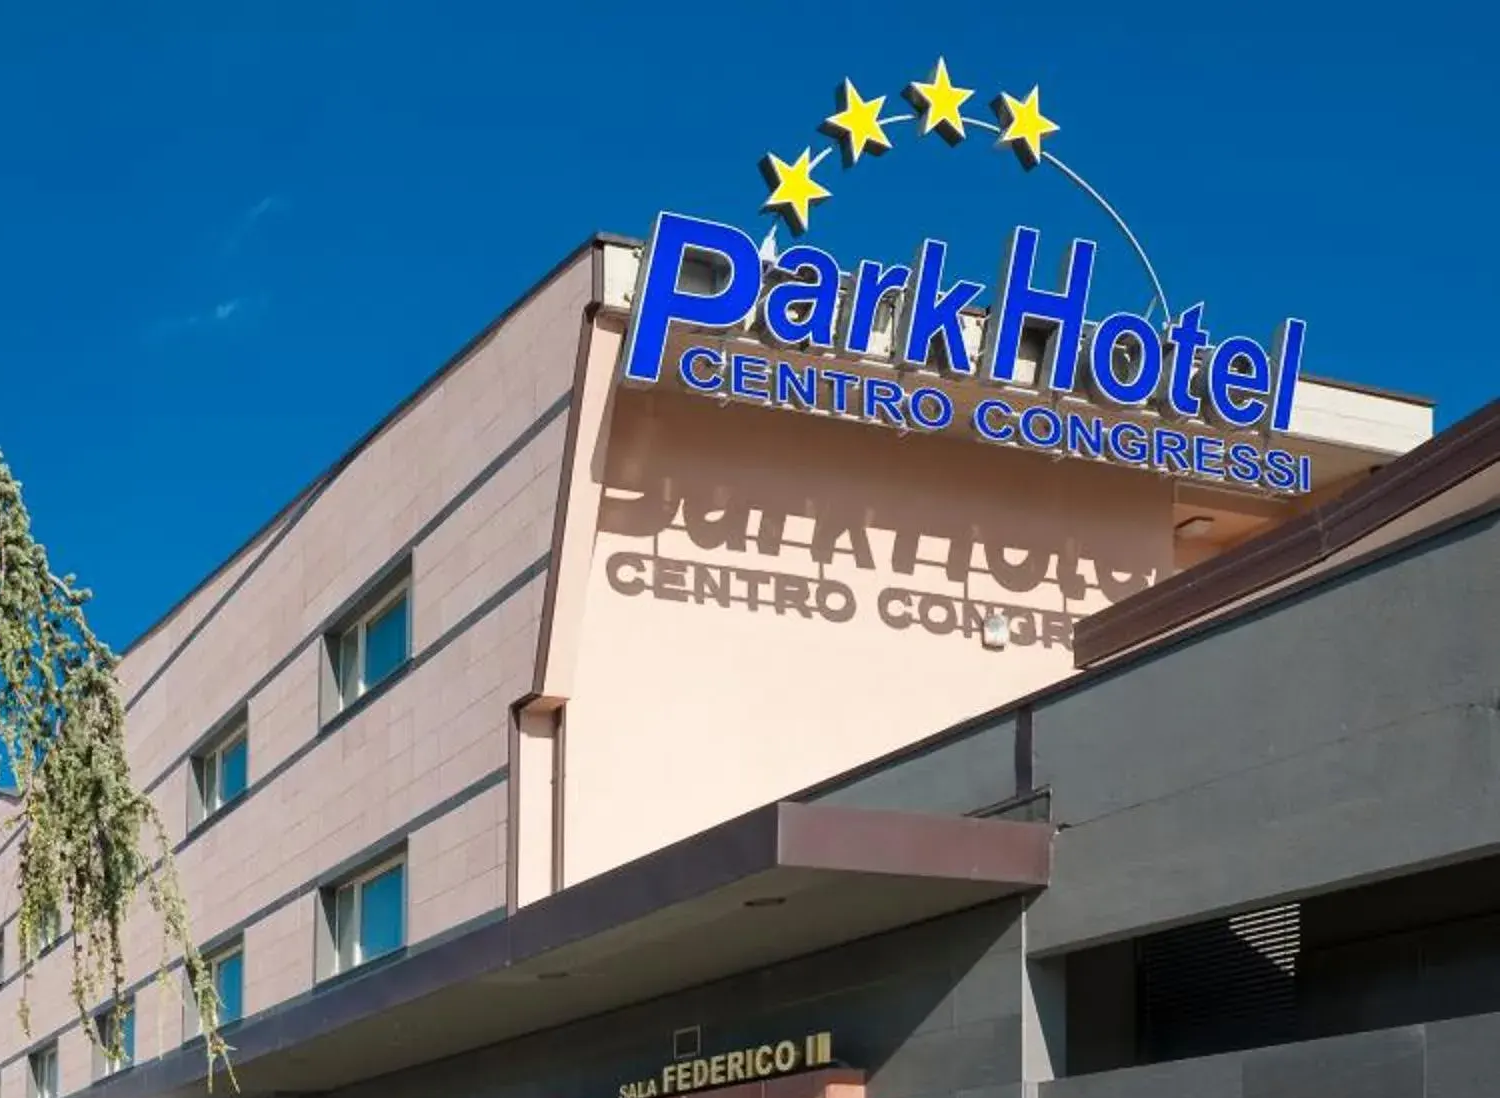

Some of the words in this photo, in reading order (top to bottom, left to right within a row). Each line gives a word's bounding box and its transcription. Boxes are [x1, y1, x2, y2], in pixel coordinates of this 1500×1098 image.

[679, 346, 953, 430] CENTRO
[972, 400, 1312, 493] CONGRESSI
[662, 1039, 796, 1094] FEDERICO
[805, 1031, 832, 1067] II
